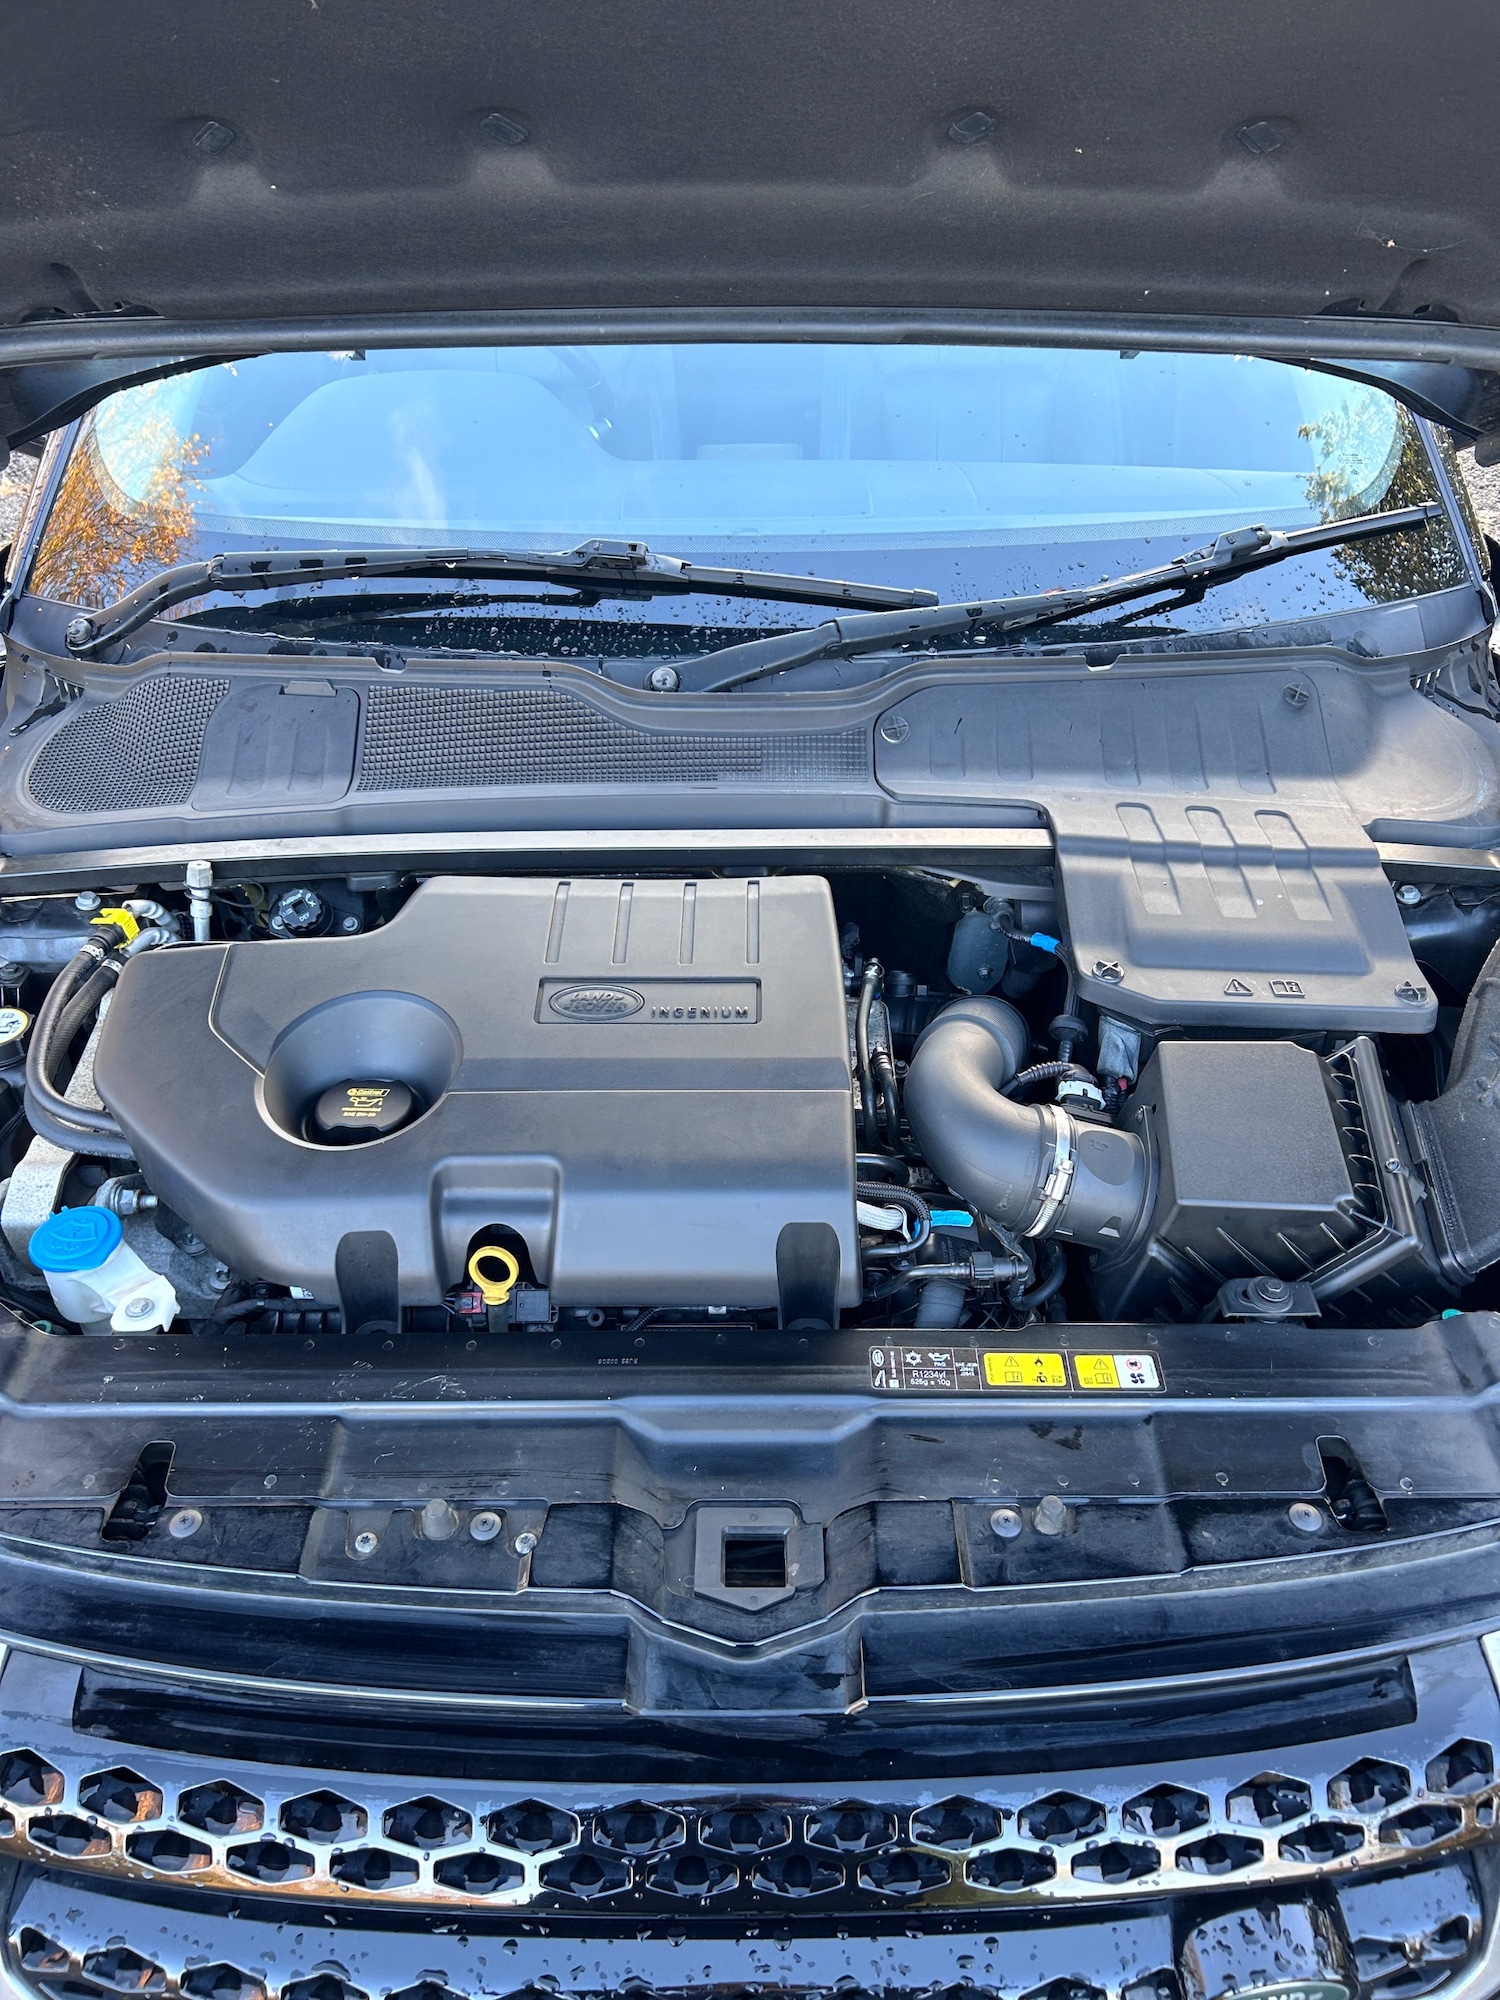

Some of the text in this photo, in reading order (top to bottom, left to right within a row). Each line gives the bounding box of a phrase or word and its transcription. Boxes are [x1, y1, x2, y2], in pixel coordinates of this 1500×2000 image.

[570, 991, 616, 1002] LAND
[567, 1001, 628, 1013] ROVER
[651, 1006, 749, 1019] INGENIUM
